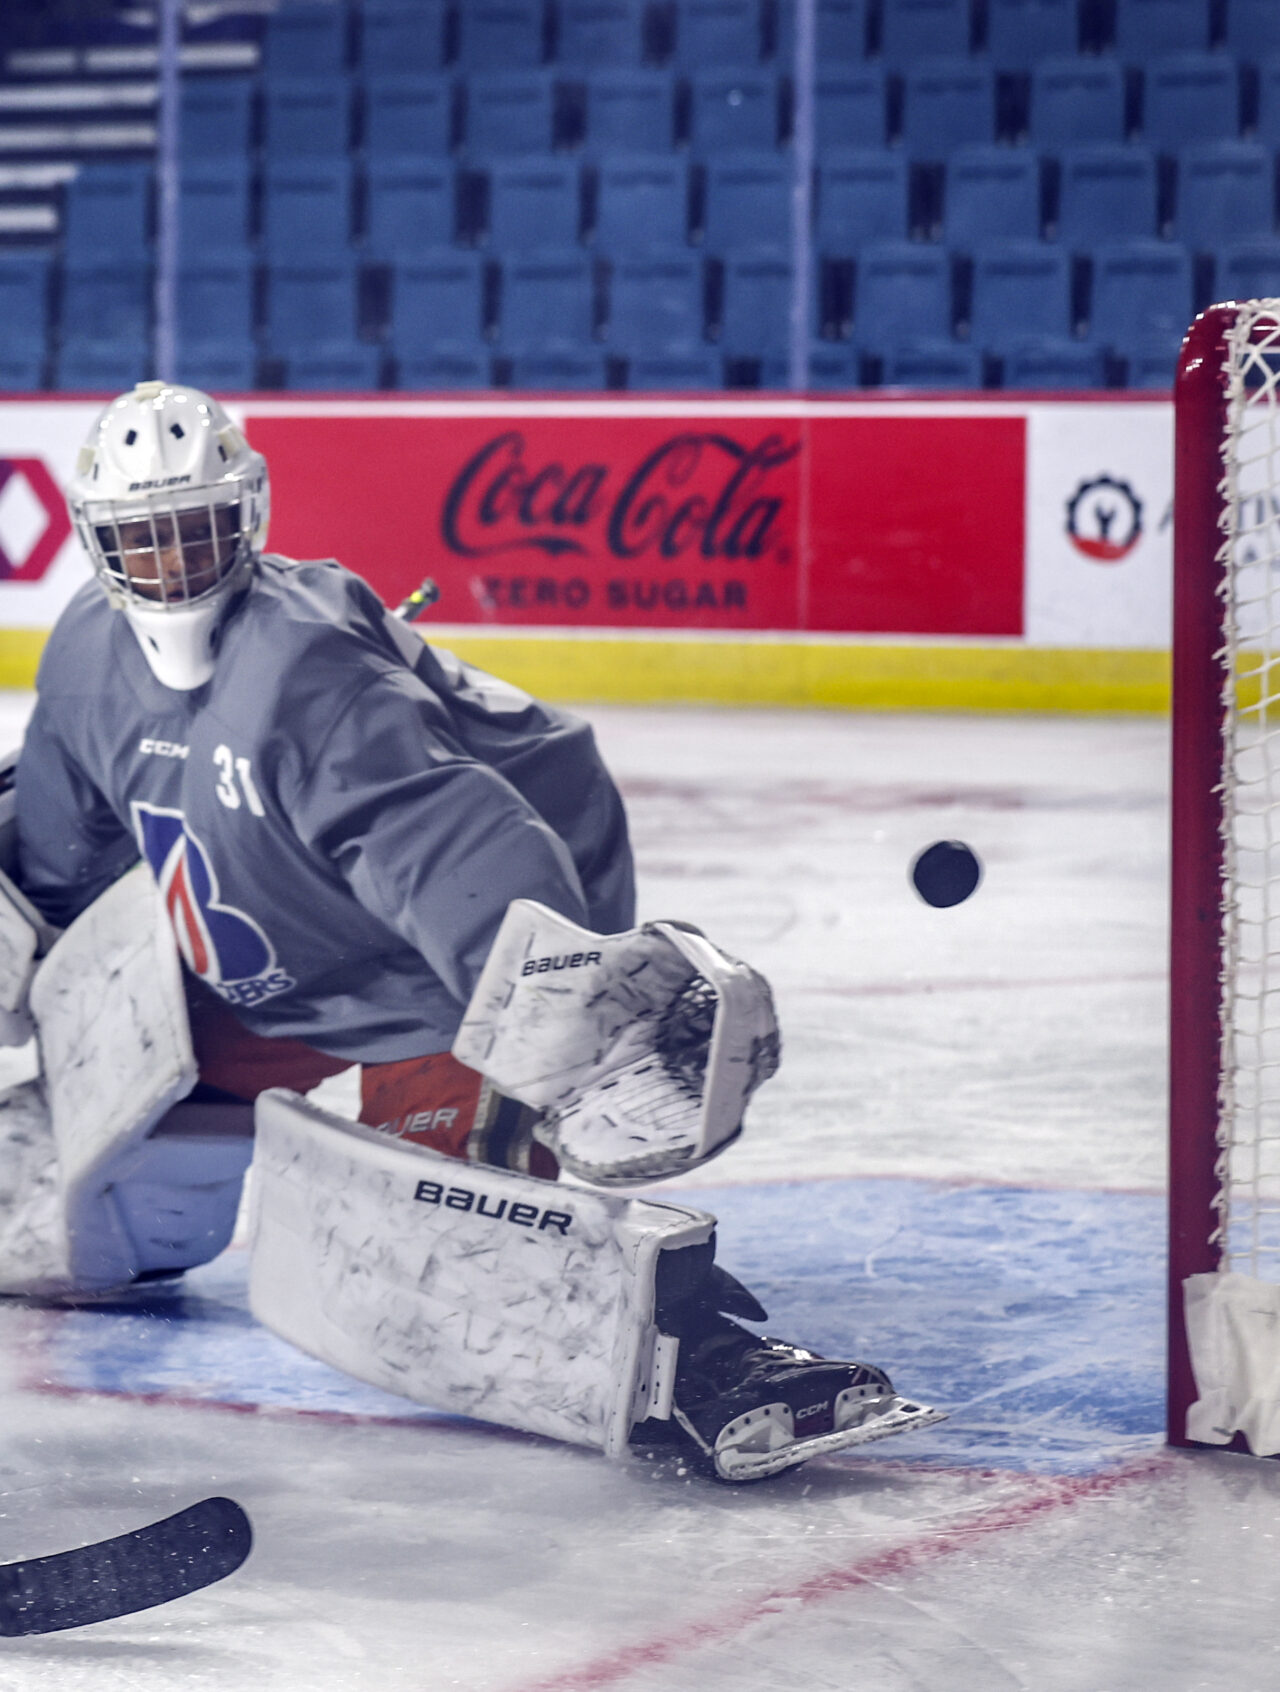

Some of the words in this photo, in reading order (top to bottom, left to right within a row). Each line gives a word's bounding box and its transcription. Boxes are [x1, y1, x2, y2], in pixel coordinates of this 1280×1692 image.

[128, 474, 192, 492] BAUER
[485, 576, 591, 609] ZERO
[607, 578, 748, 611] SUGAR
[138, 737, 190, 759] CCM
[213, 744, 266, 818] 31
[520, 951, 602, 977] BAUER
[413, 1179, 573, 1236] BAUER
[795, 1400, 829, 1419] CCM
